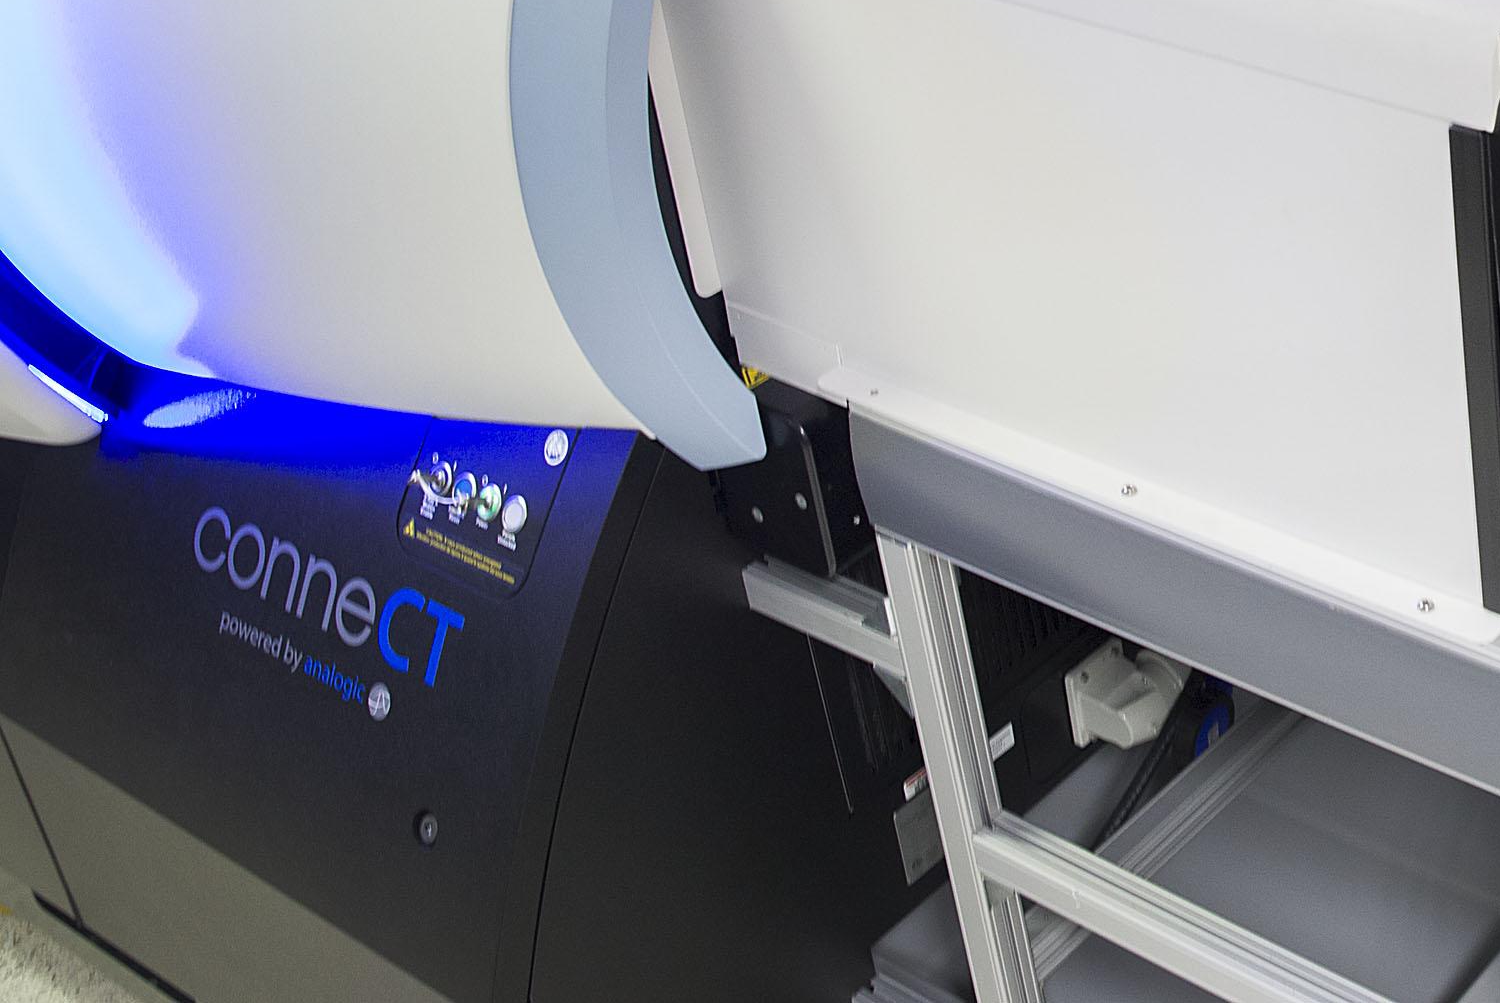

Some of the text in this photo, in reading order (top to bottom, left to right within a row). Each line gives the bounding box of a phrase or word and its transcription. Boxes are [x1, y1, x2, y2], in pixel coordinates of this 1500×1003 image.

[194, 506, 465, 688] conneCT
[219, 610, 366, 704] powered by analogic
